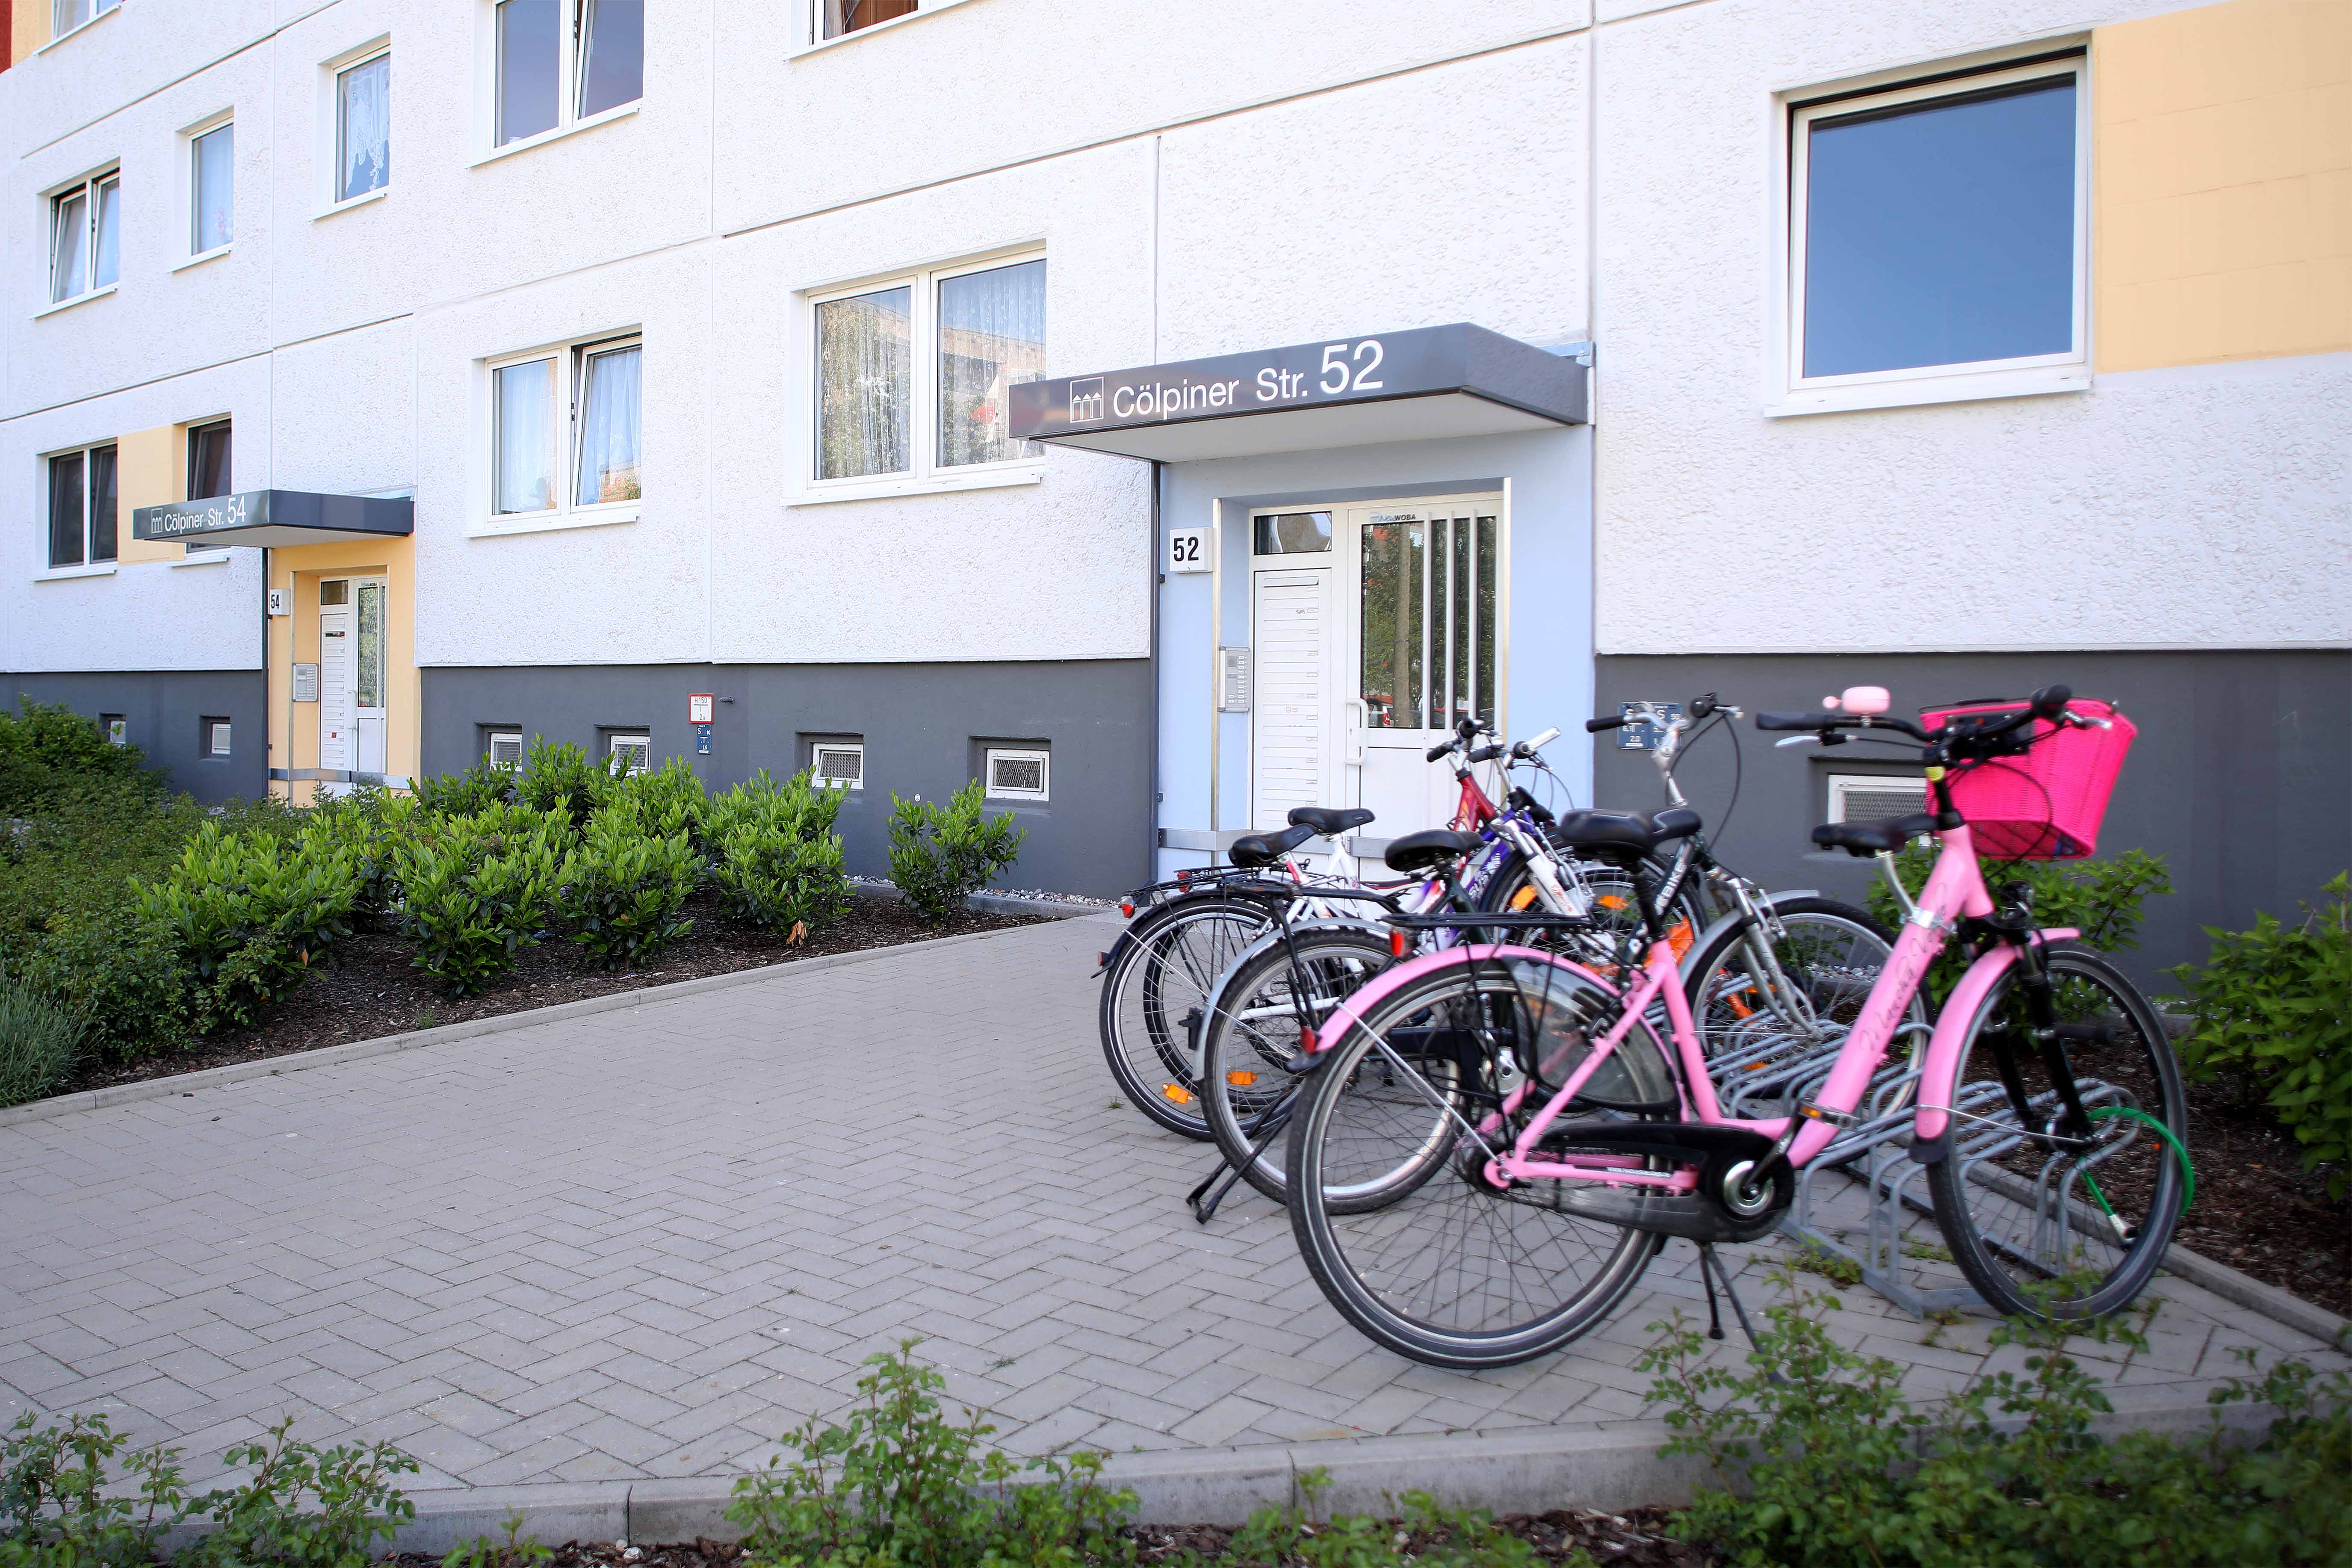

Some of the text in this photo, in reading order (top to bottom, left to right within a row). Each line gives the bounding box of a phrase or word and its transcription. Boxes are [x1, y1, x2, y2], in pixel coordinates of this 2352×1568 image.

[1113, 340, 1384, 420] Cölpiner Str. 52
[164, 495, 247, 534] Cölpiner Str. 54
[1173, 536, 1199, 561] 52
[271, 594, 280, 609] 54
[1656, 709, 1666, 720] S
